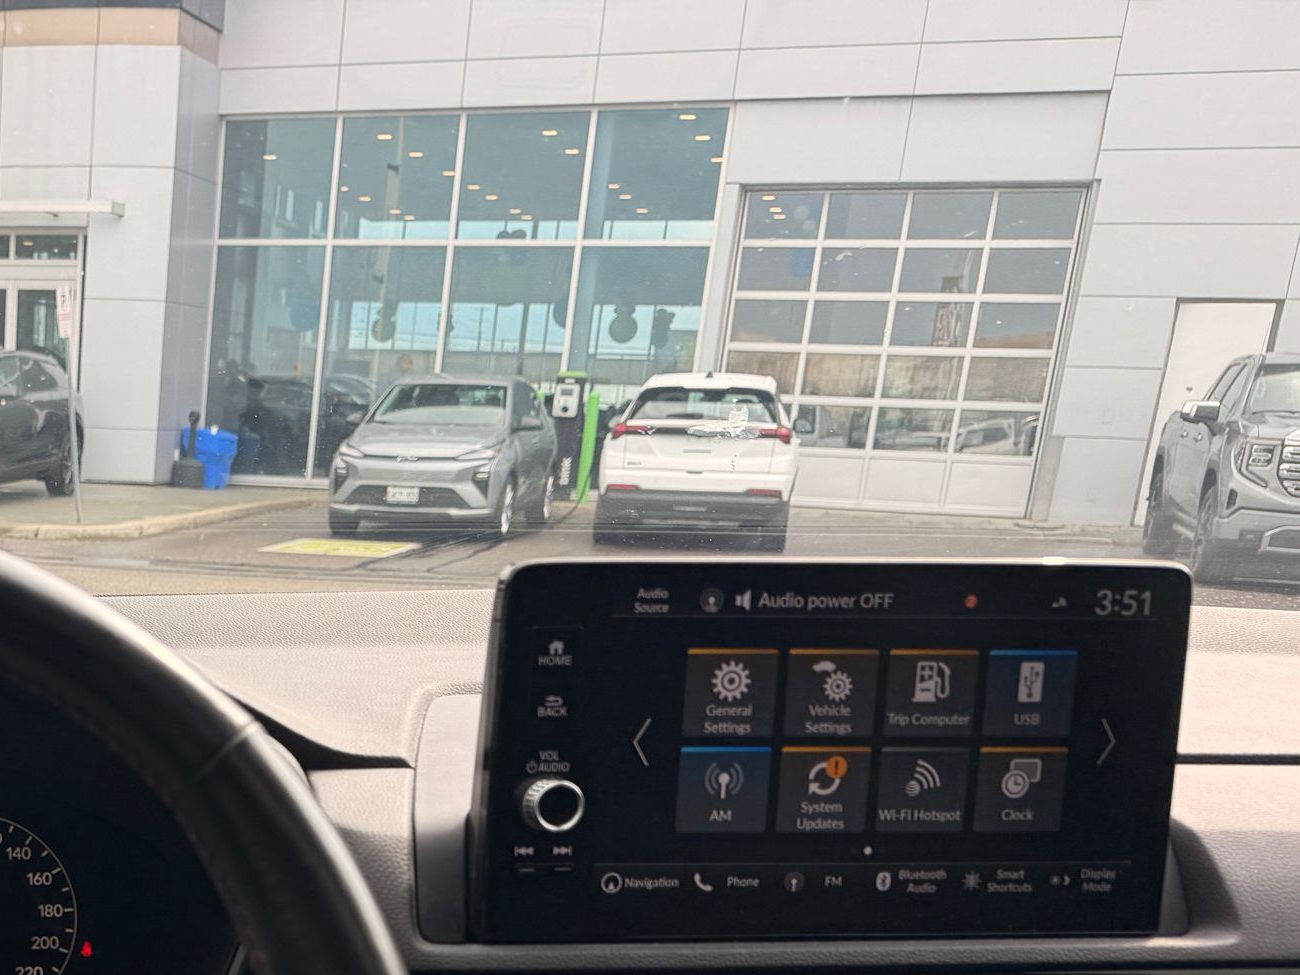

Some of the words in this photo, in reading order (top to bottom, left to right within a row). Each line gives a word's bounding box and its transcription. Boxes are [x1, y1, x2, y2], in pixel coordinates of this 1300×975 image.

[637, 587, 669, 599] Audio
[633, 601, 670, 614] Source
[757, 591, 804, 608] Audio
[807, 595, 857, 611] power
[859, 592, 895, 609] OFF
[1094, 589, 1153, 616] 3:51
[538, 655, 572, 666] HOME
[537, 706, 568, 717] BACK
[706, 704, 752, 717] General
[808, 704, 852, 717] Vehicle
[887, 712, 908, 728] Trip
[911, 712, 971, 728] Computer
[1013, 712, 1041, 726] USB
[703, 721, 751, 736] Settings
[804, 721, 852, 736] Settings
[538, 751, 560, 761] VOL
[538, 761, 570, 773] AUDIO
[800, 801, 843, 816] System
[1000, 808, 1033, 821] Clock
[709, 809, 732, 822] AM
[878, 808, 910, 821] Wi-Fi
[913, 808, 961, 824] Hotspot
[796, 817, 844, 832] Updates
[5, 846, 32, 861] 140
[26, 872, 53, 886] 160
[898, 868, 947, 881] Bluetooth
[996, 867, 1025, 880] Smart
[1080, 867, 1117, 882] Display
[624, 876, 680, 891] Navigation
[726, 876, 760, 888] Phone
[824, 875, 843, 887] FM
[906, 882, 937, 893] Audio
[986, 882, 1033, 893] Shortcuts
[1081, 881, 1112, 892] Mode
[37, 903, 63, 918] 180
[31, 936, 60, 950] 200
